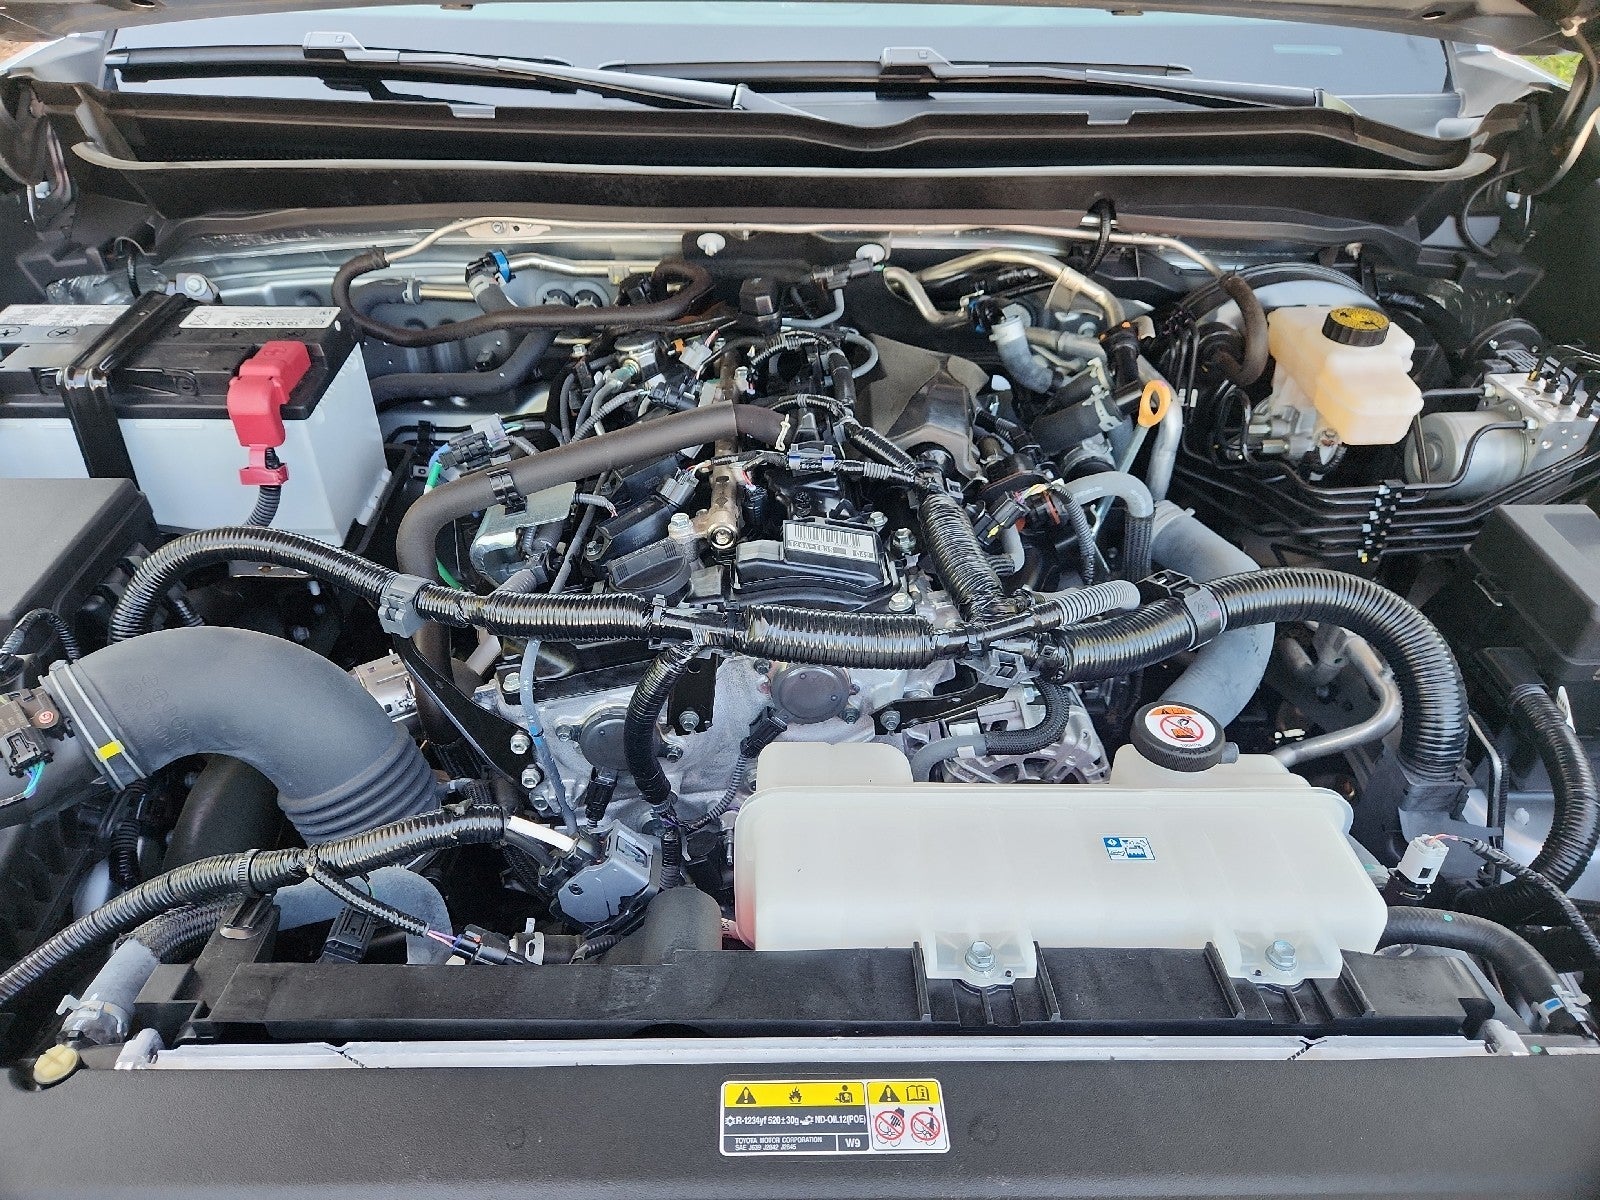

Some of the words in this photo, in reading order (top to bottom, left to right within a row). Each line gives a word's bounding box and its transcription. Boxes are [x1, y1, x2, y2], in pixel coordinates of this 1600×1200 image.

[735, 1115, 767, 1126] R-1234yf
[768, 1115, 799, 1126] 520±30g
[735, 1137, 757, 1145] TOYOTA
[845, 1138, 860, 1148] W9
